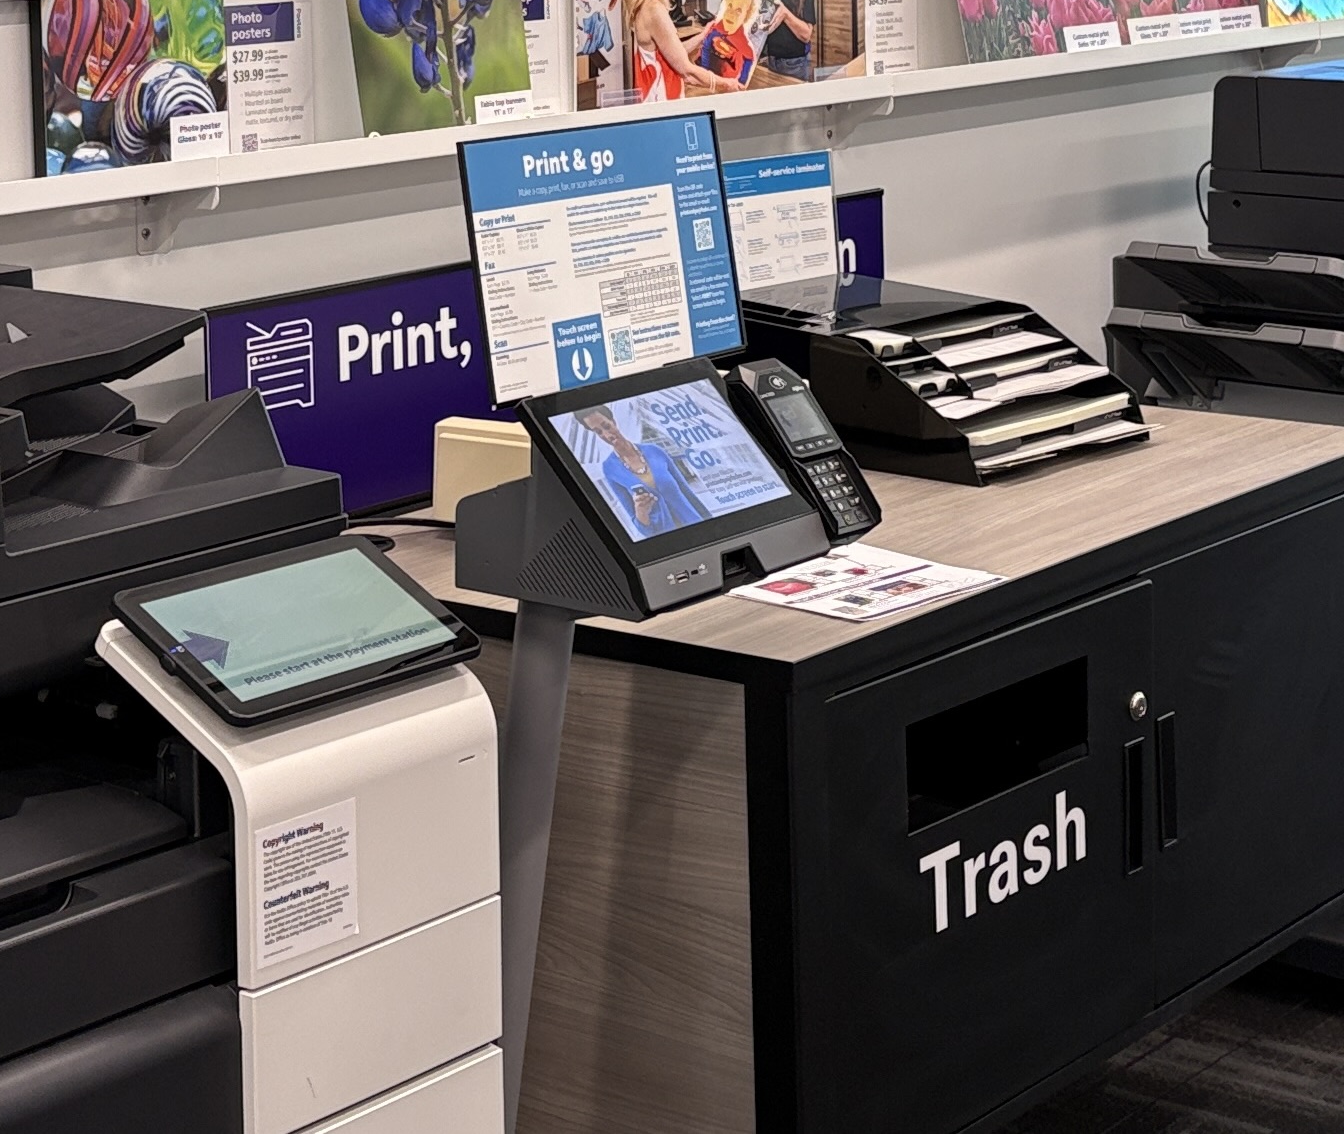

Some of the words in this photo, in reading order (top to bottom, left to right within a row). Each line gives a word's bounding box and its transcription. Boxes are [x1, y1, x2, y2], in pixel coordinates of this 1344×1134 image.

[231, 12, 263, 25] Photo
[231, 27, 271, 43] posters
[232, 49, 263, 64] $27.99
[233, 68, 264, 84] $39.99
[522, 149, 570, 178] Print
[572, 148, 587, 173] &
[589, 149, 614, 174] go
[758, 165, 795, 179] Self-service
[337, 304, 471, 383] Print,
[651, 394, 705, 425] Send.
[685, 448, 722, 470] Go.
[244, 669, 283, 686] Please
[283, 660, 311, 675] start
[311, 657, 323, 668] at
[323, 651, 345, 663] the
[344, 637, 392, 659] payment
[391, 626, 429, 643] station
[263, 830, 296, 849] Copyright
[297, 821, 324, 838] Warning
[919, 789, 1087, 933] Trash
[263, 889, 301, 910] Counterfeit
[302, 880, 330, 896] Warning
